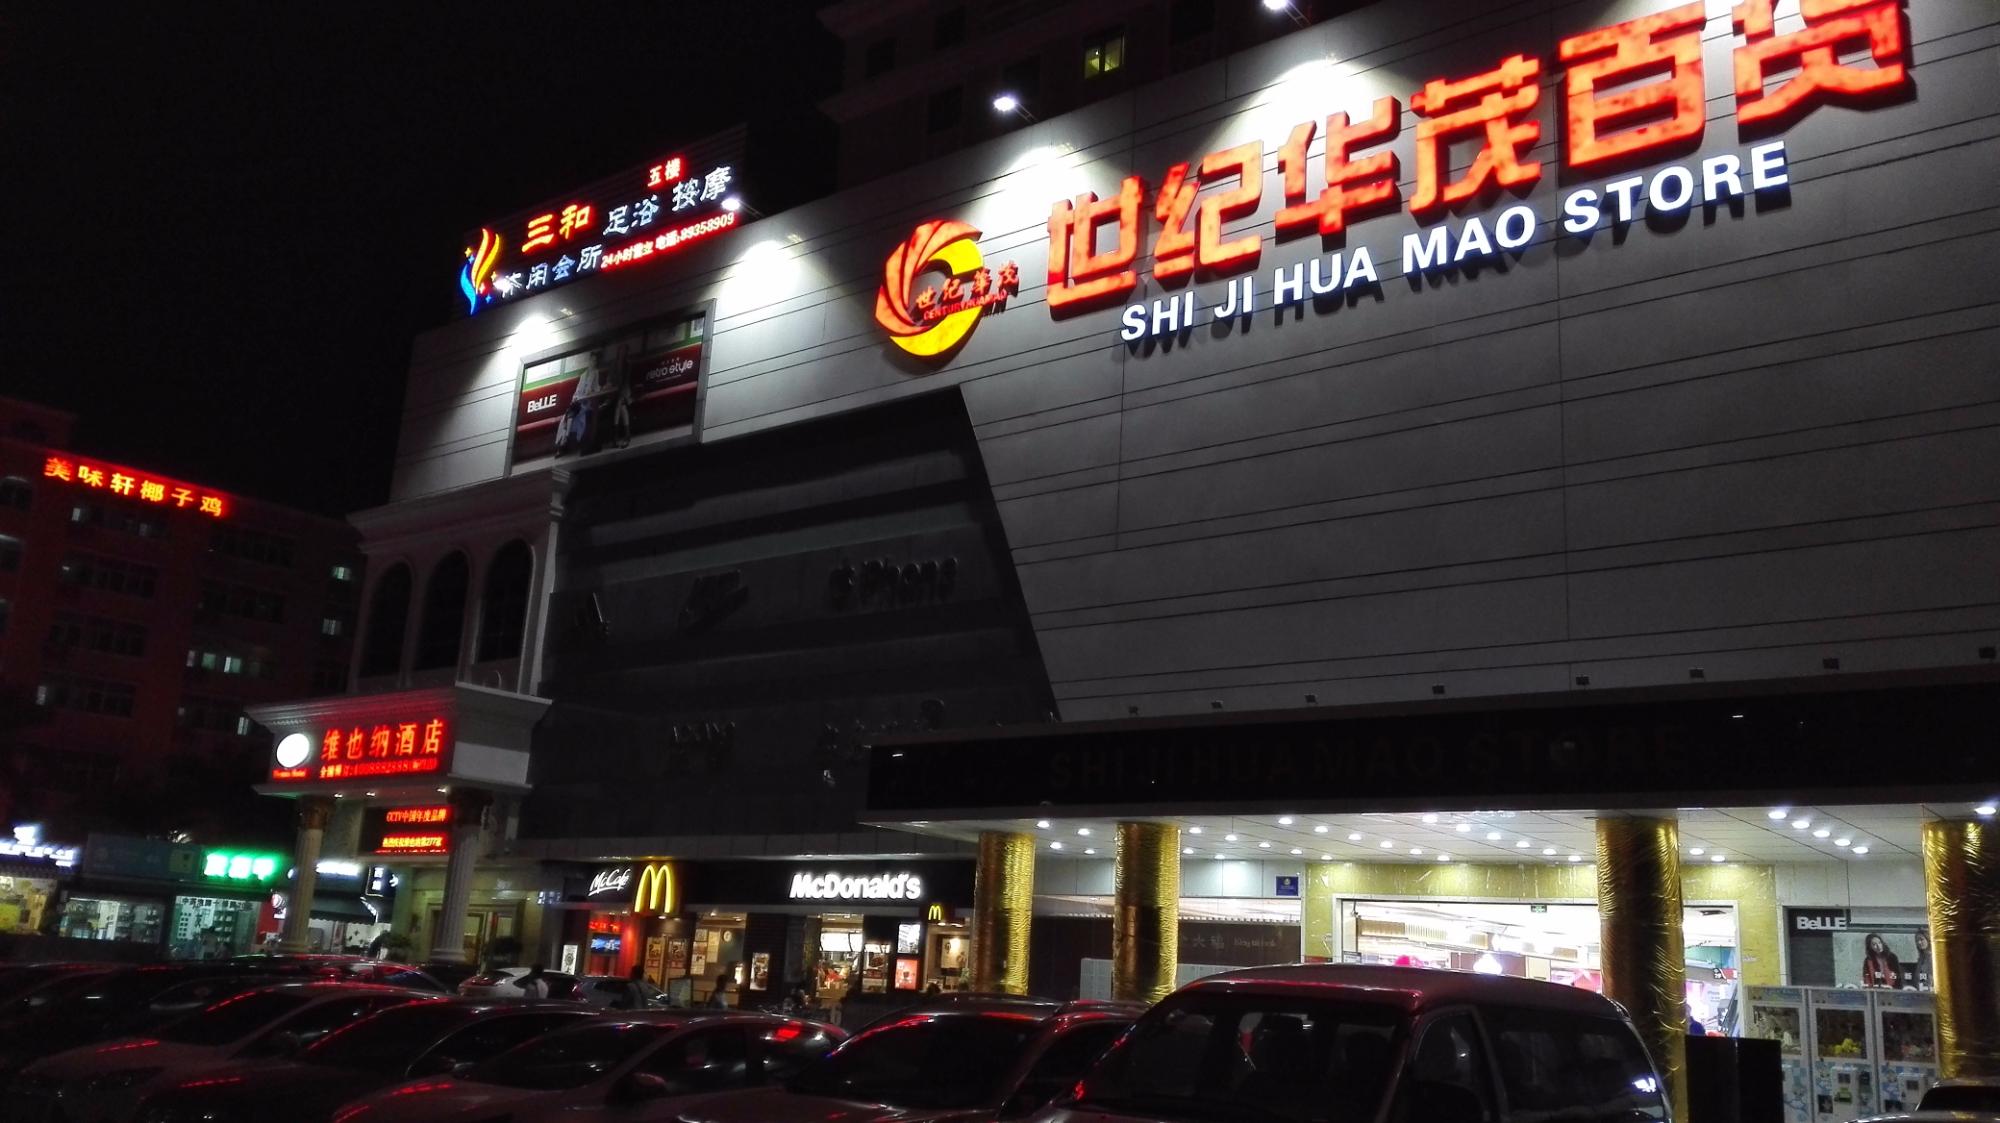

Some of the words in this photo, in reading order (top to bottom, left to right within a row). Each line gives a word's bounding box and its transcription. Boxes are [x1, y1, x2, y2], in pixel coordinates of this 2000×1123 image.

[647, 158, 682, 187] 五楼
[1045, 0, 1914, 310] 世纪华茂百货
[521, 203, 592, 253] 三和
[602, 194, 660, 236] 足浴
[671, 165, 733, 213] 按摩
[1120, 289, 1195, 343] SHI
[1213, 276, 1254, 319] JI
[1272, 246, 1379, 306] HUA
[1401, 204, 1537, 275] MAO
[1562, 140, 1790, 235] STORE
[44, 458, 222, 517] 美味轩椰子鸡
[319, 718, 444, 761] 维也纳酒店
[789, 872, 922, 901] McDonald's
